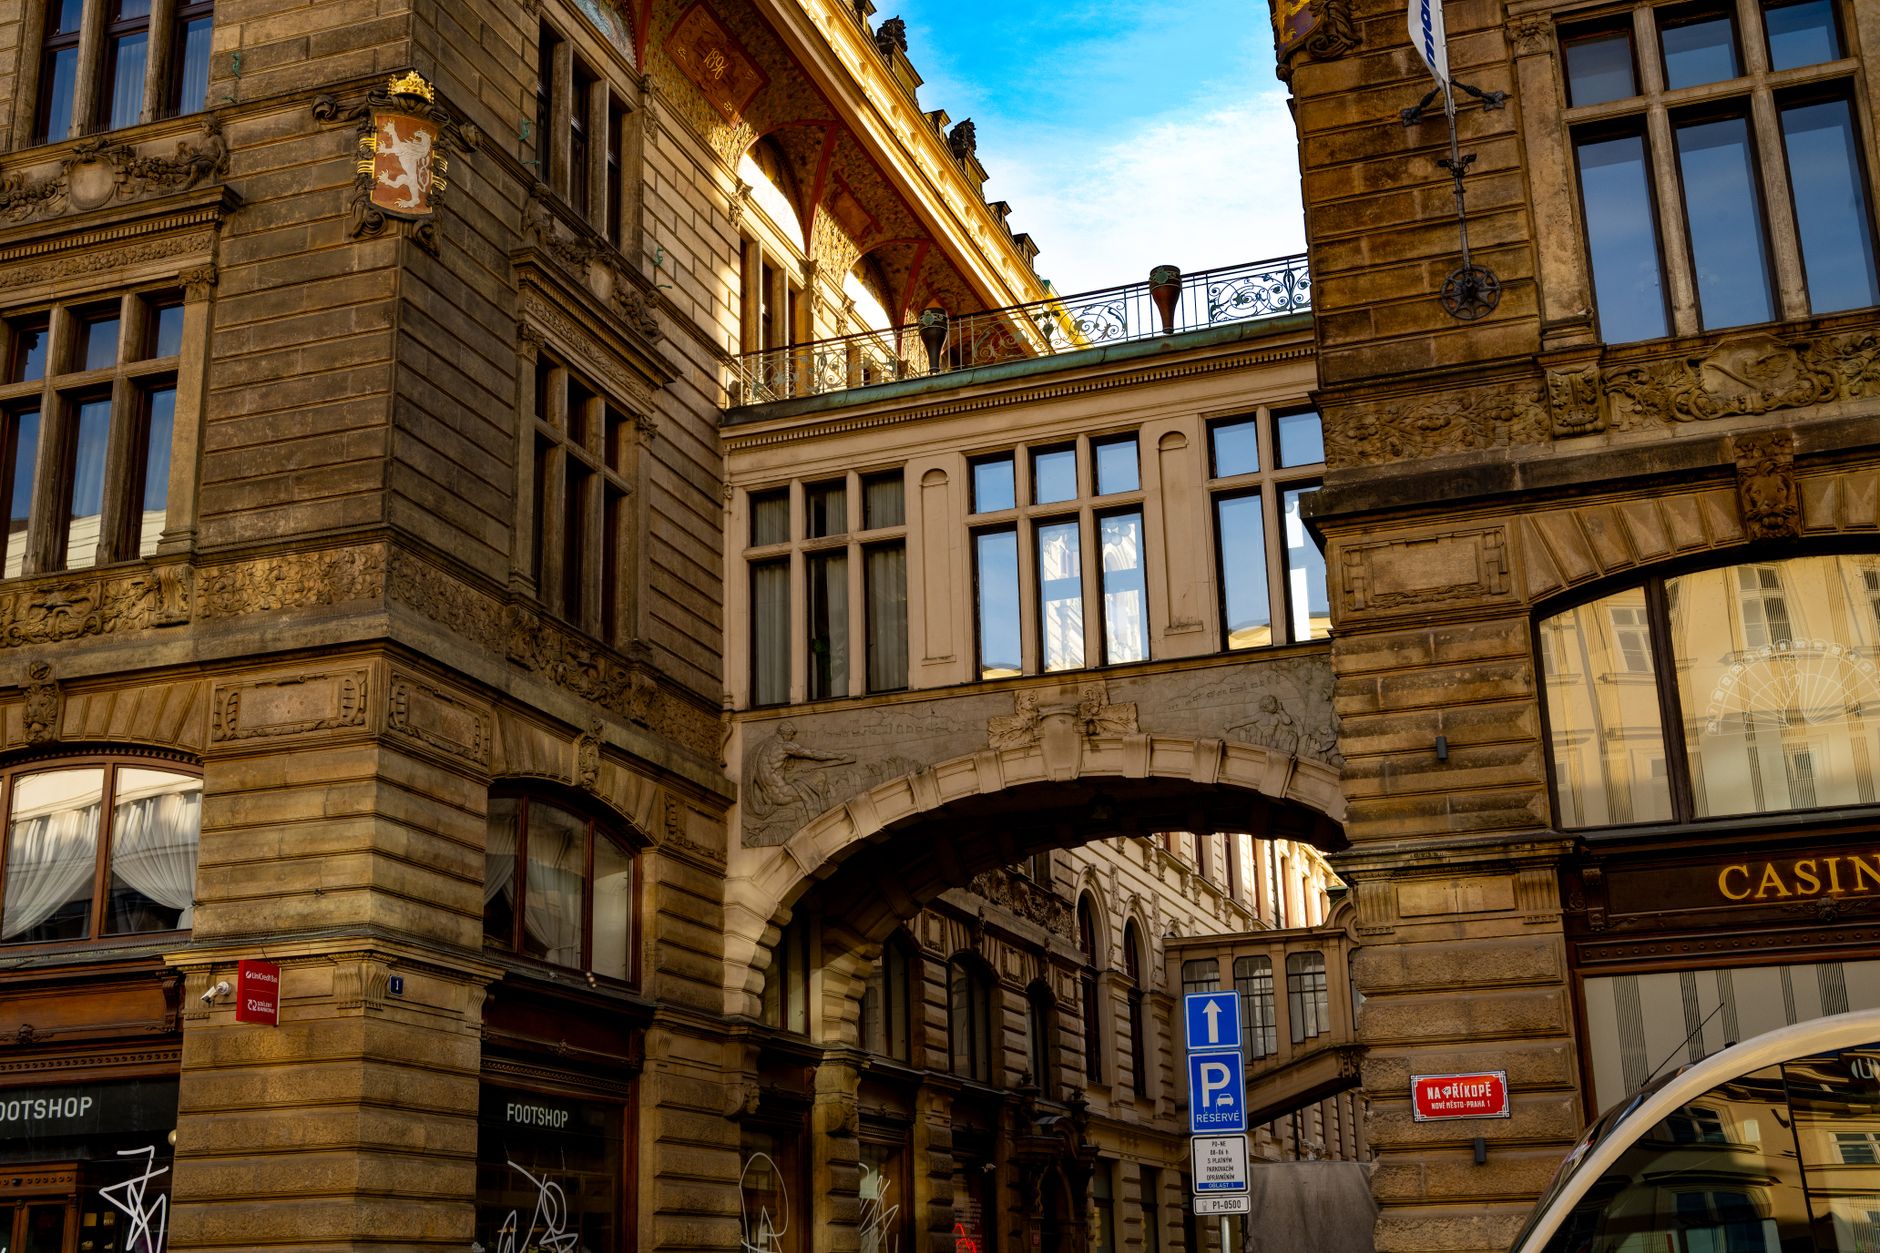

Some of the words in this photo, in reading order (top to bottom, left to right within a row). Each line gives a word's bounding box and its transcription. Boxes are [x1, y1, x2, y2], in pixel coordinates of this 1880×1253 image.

[704, 48, 729, 80] 1896
[1718, 854, 1880, 900] CASIN
[1200, 1062, 1231, 1107] P
[1426, 1086, 1441, 1100] NA
[1444, 1081, 1492, 1099] PŘÍKOPĚ
[506, 1103, 569, 1129] FOOTSHOP
[1431, 1100, 1446, 1110] NOVÉ
[1212, 1200, 1242, 1210] P1-0500
